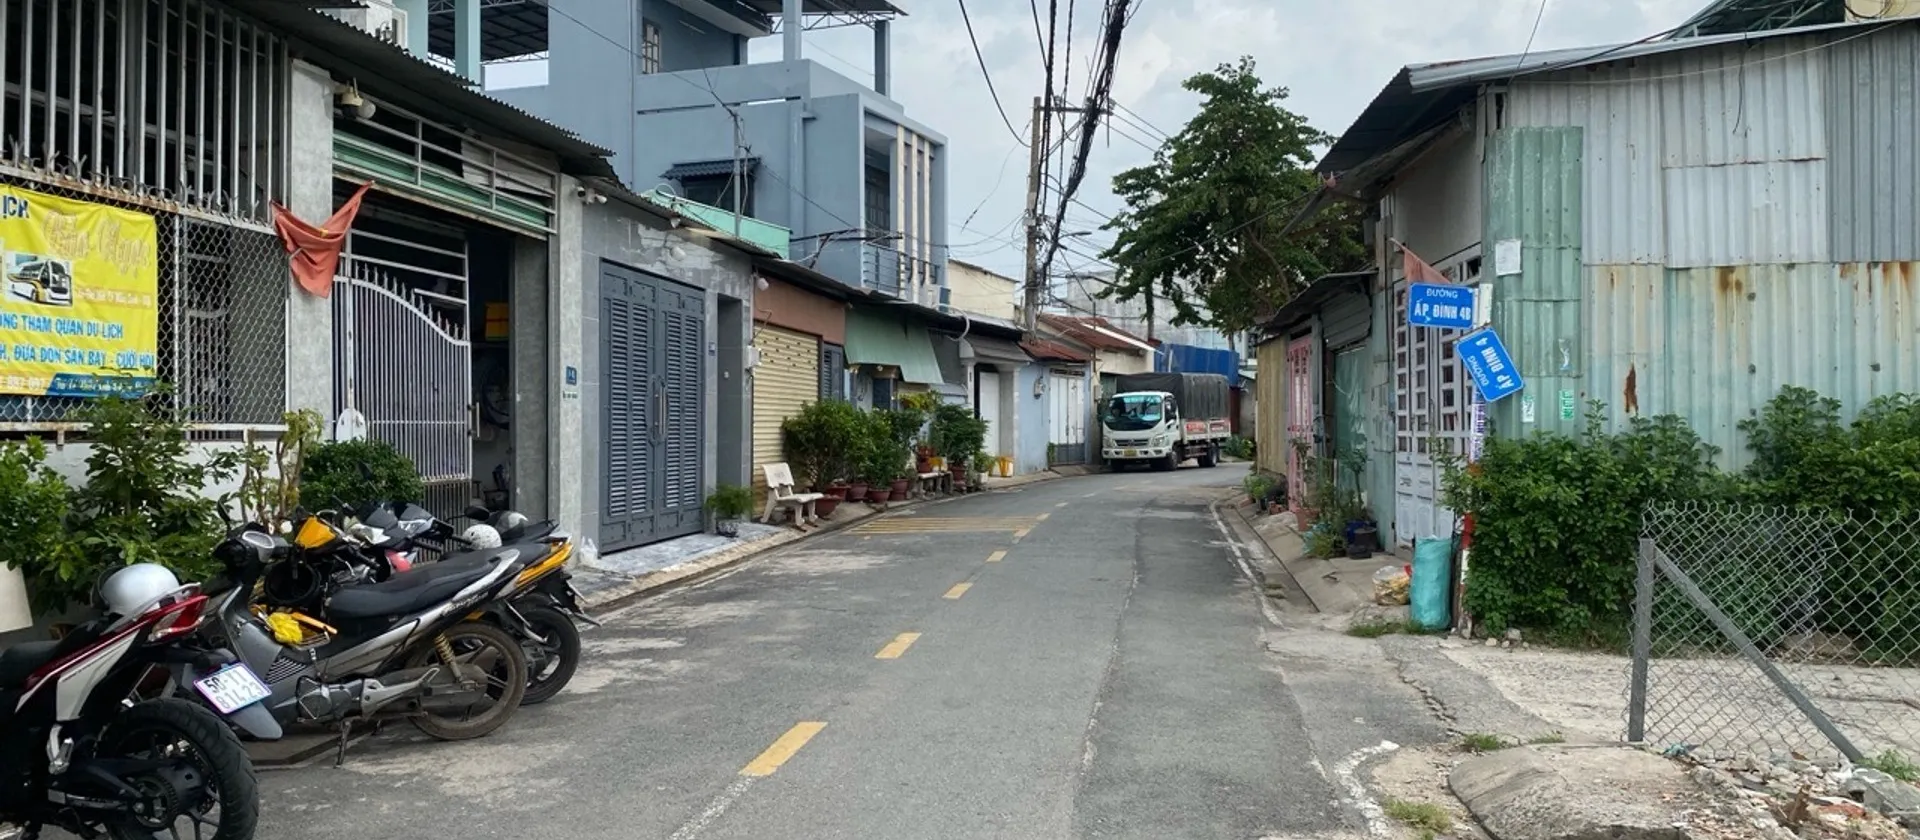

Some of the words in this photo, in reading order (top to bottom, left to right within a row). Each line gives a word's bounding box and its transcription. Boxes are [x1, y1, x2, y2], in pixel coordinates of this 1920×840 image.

[1426, 287, 1458, 299] ĐƯỜNG
[1459, 306, 1471, 320] 4B
[21, 315, 51, 333] THAM
[55, 318, 83, 336] QUAN
[86, 322, 98, 337] DU
[101, 323, 123, 342] LỊCH
[1475, 336, 1488, 346] 4
[88, 349, 106, 367] BAY
